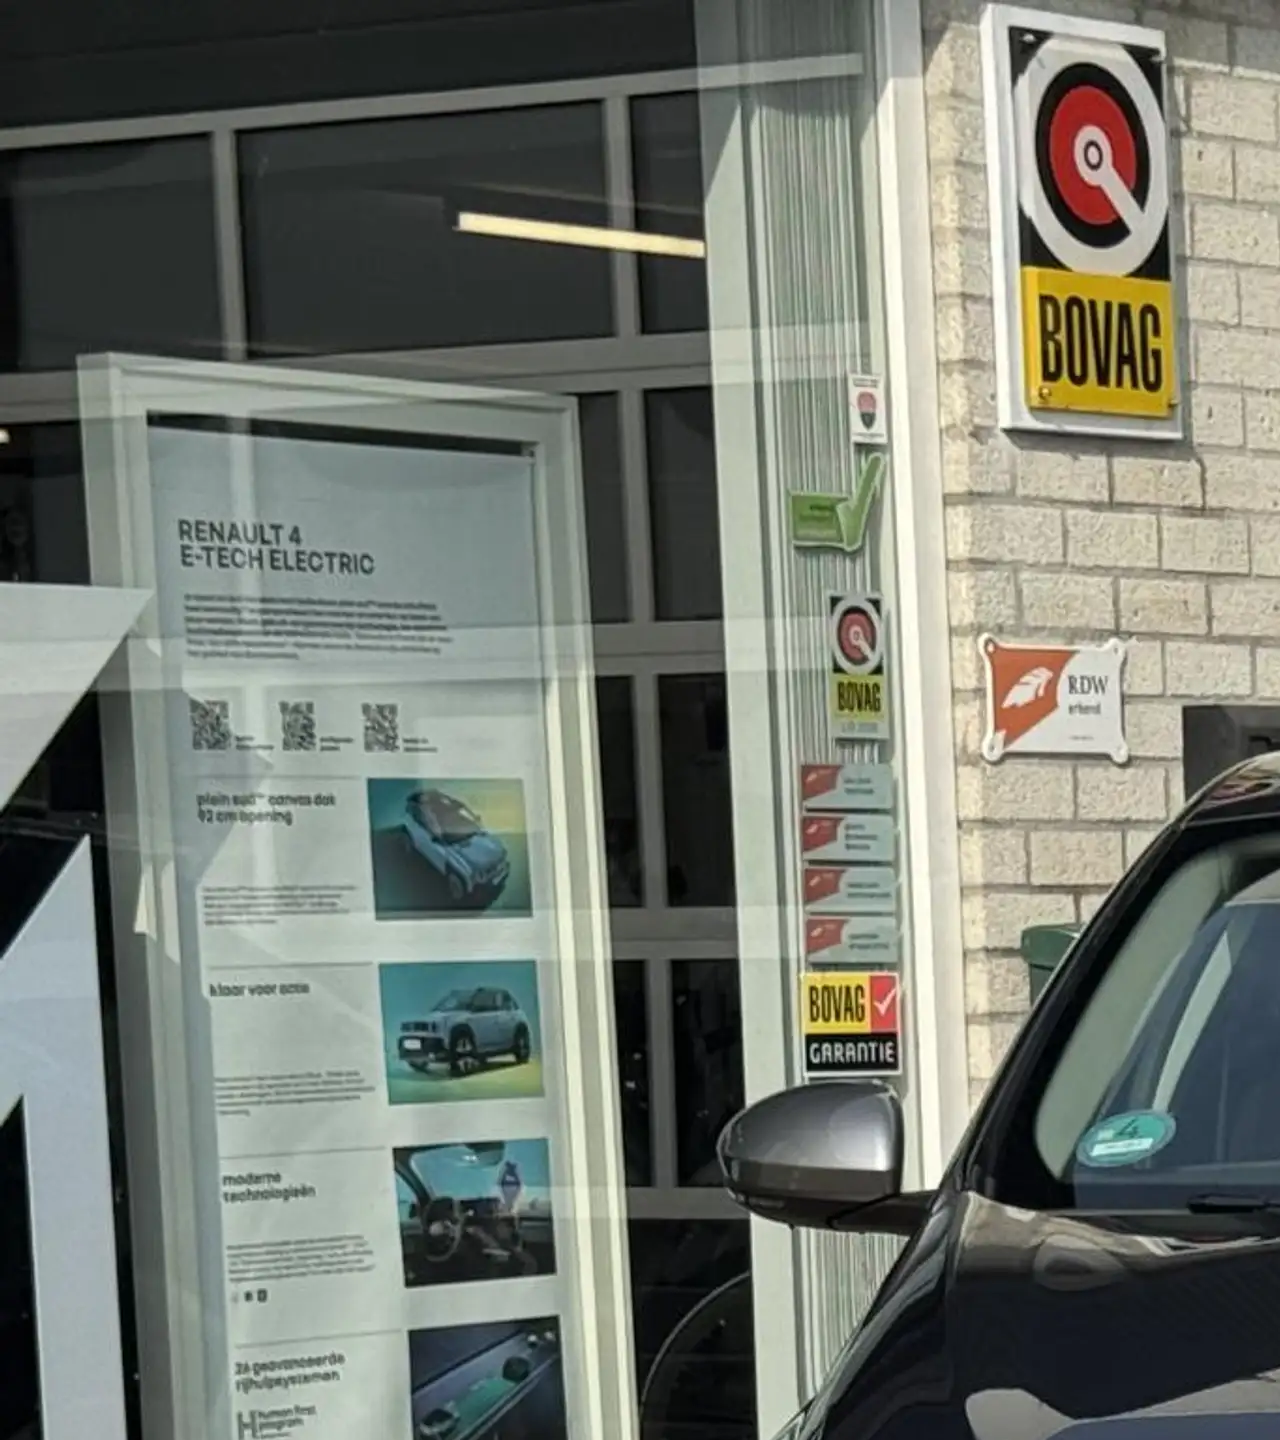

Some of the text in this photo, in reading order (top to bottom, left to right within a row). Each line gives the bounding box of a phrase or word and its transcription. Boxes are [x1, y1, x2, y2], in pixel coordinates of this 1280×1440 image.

[1038, 293, 1163, 393] BOVAG
[178, 519, 303, 546] RENAULT 4
[180, 545, 375, 576] E-TECH ELECTRIC
[837, 681, 881, 713] BOVAG
[1068, 675, 1108, 695] RDW
[809, 984, 866, 1024] BOVAG
[808, 1041, 896, 1064] GARANTIE
[222, 1172, 282, 1186] moderne
